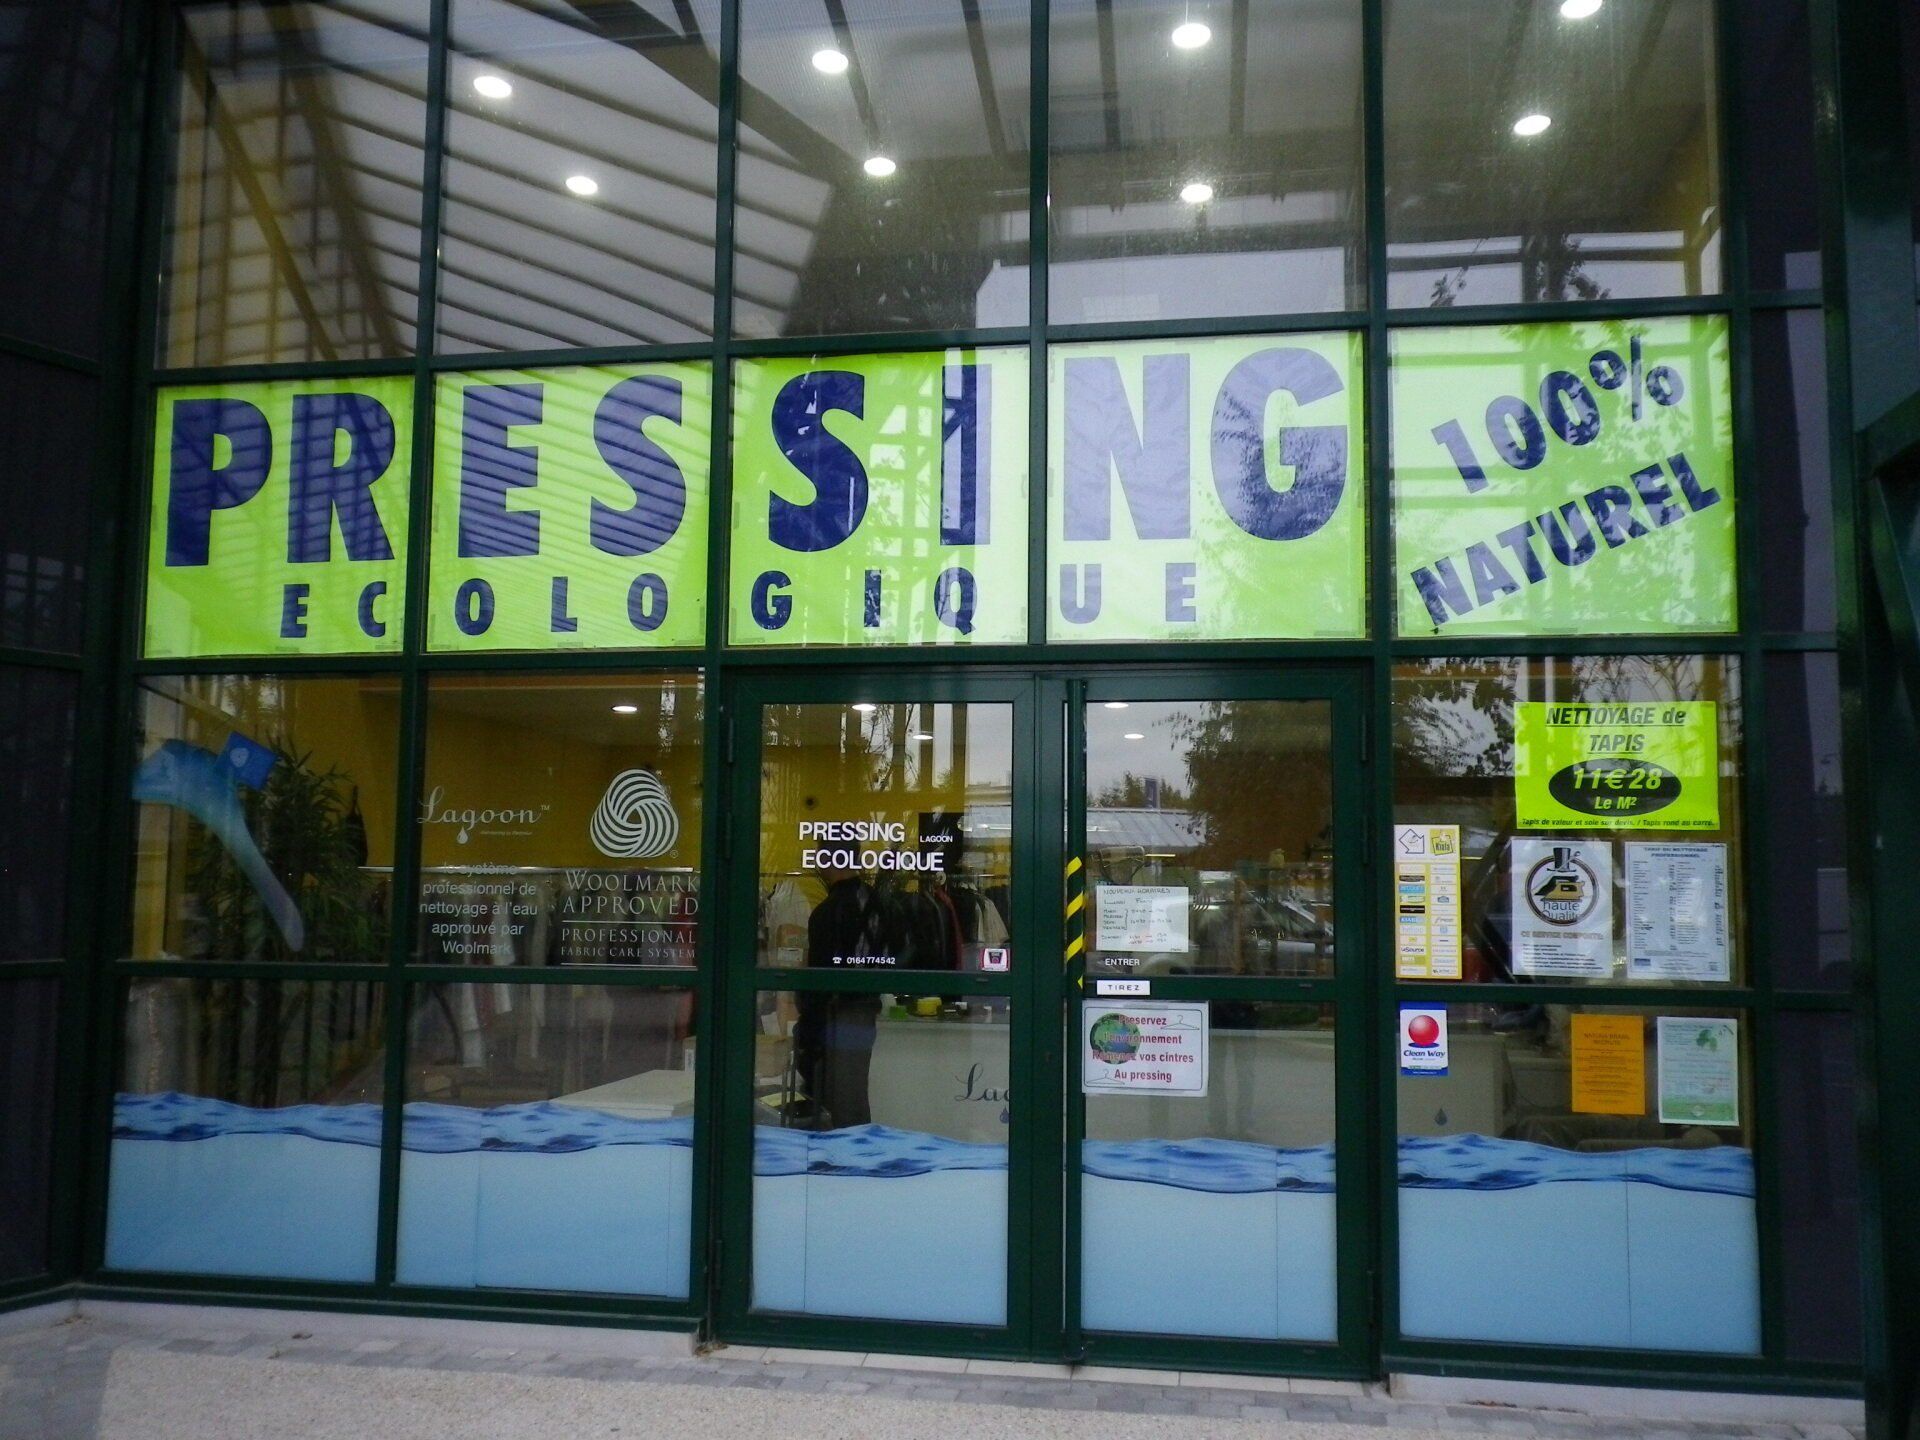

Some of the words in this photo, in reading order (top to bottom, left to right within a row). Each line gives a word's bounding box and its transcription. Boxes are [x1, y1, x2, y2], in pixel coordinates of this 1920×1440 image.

[1430, 333, 1684, 494] 100%
[165, 343, 1348, 566] PRESSING
[1410, 452, 1721, 626] NATUREL
[280, 562, 1197, 638] ECOLOGIQUE
[1546, 707, 1656, 725] NETTOYAGE
[1662, 706, 1687, 725] de
[1589, 733, 1645, 751] TAPIS
[416, 785, 541, 831] Lagoon
[1594, 796, 1611, 810] Le
[1522, 818, 1540, 826] Tapis
[1642, 819, 1661, 827] Tapis
[799, 821, 905, 842] PRESSING
[919, 835, 953, 843] LAGOON
[802, 849, 944, 872] ECOLOGIQUE
[422, 881, 517, 897] professionnel
[520, 882, 537, 896] de
[565, 869, 699, 893] WOOLMARK
[419, 901, 488, 918] nettoyage
[503, 901, 538, 916] l'eau
[562, 896, 699, 916] APPROVED
[1542, 900, 1580, 911] haute
[431, 921, 497, 937] approuvé
[502, 923, 525, 937] par
[561, 927, 697, 945] PROFESSIONAL
[442, 940, 512, 956] Woolmark
[561, 946, 604, 957] FABRIC
[609, 947, 642, 957] CARE
[648, 948, 696, 958] SYSTEM
[1105, 958, 1140, 967] ENTRER
[1139, 1053, 1156, 1062] vos
[1159, 1052, 1194, 1063] cintres
[1403, 1049, 1426, 1057] Clean
[1427, 1050, 1446, 1058] Way
[1114, 1069, 1127, 1079] Au
[1130, 1070, 1172, 1083] pressing
